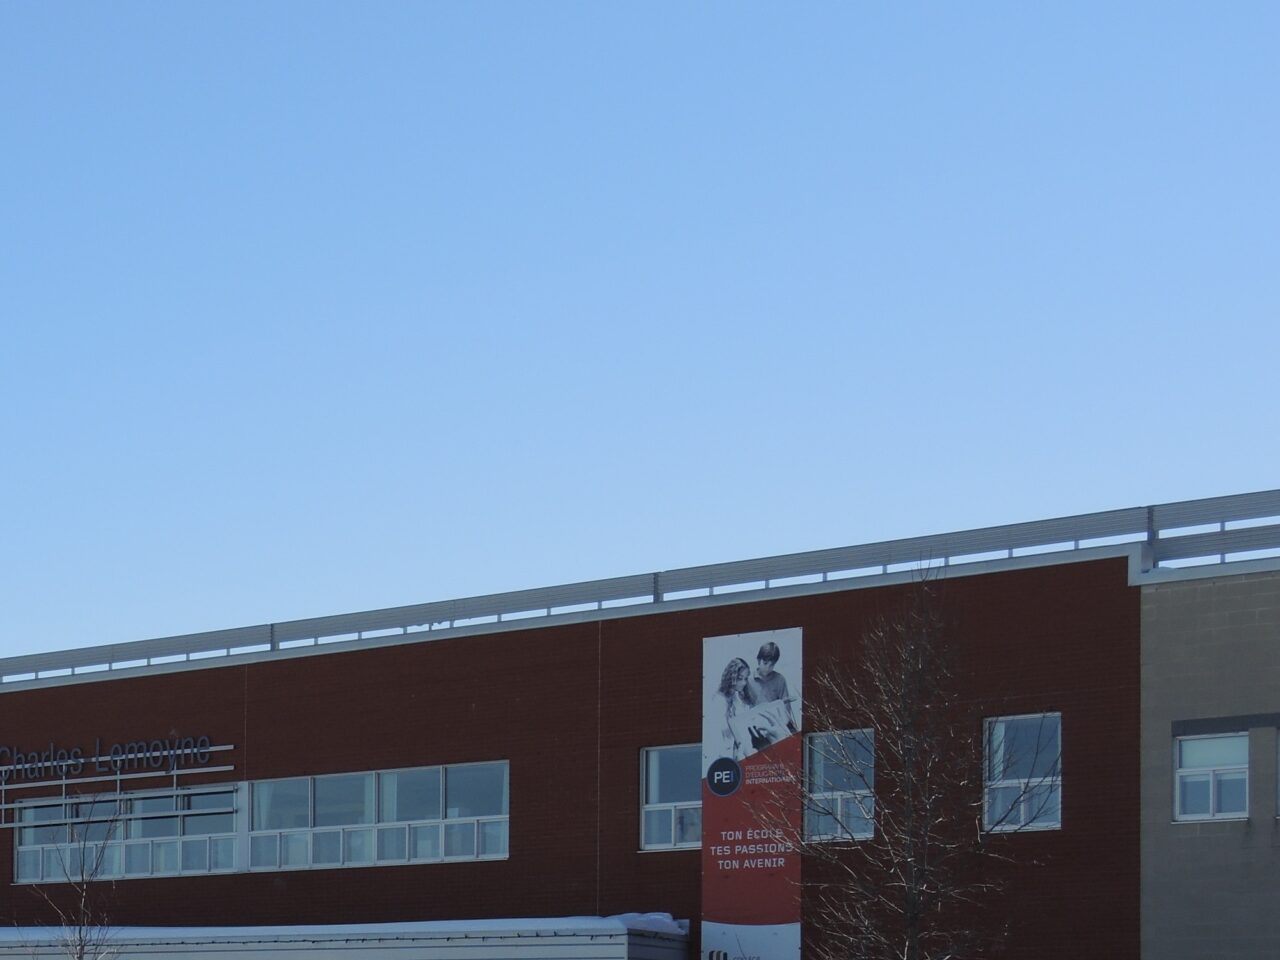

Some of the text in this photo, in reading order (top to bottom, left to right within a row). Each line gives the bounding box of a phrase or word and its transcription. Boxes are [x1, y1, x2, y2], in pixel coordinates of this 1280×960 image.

[721, 831, 742, 841] TON
[710, 843, 793, 856] TES PASSIONS
[718, 858, 785, 870] TON AVENIR
